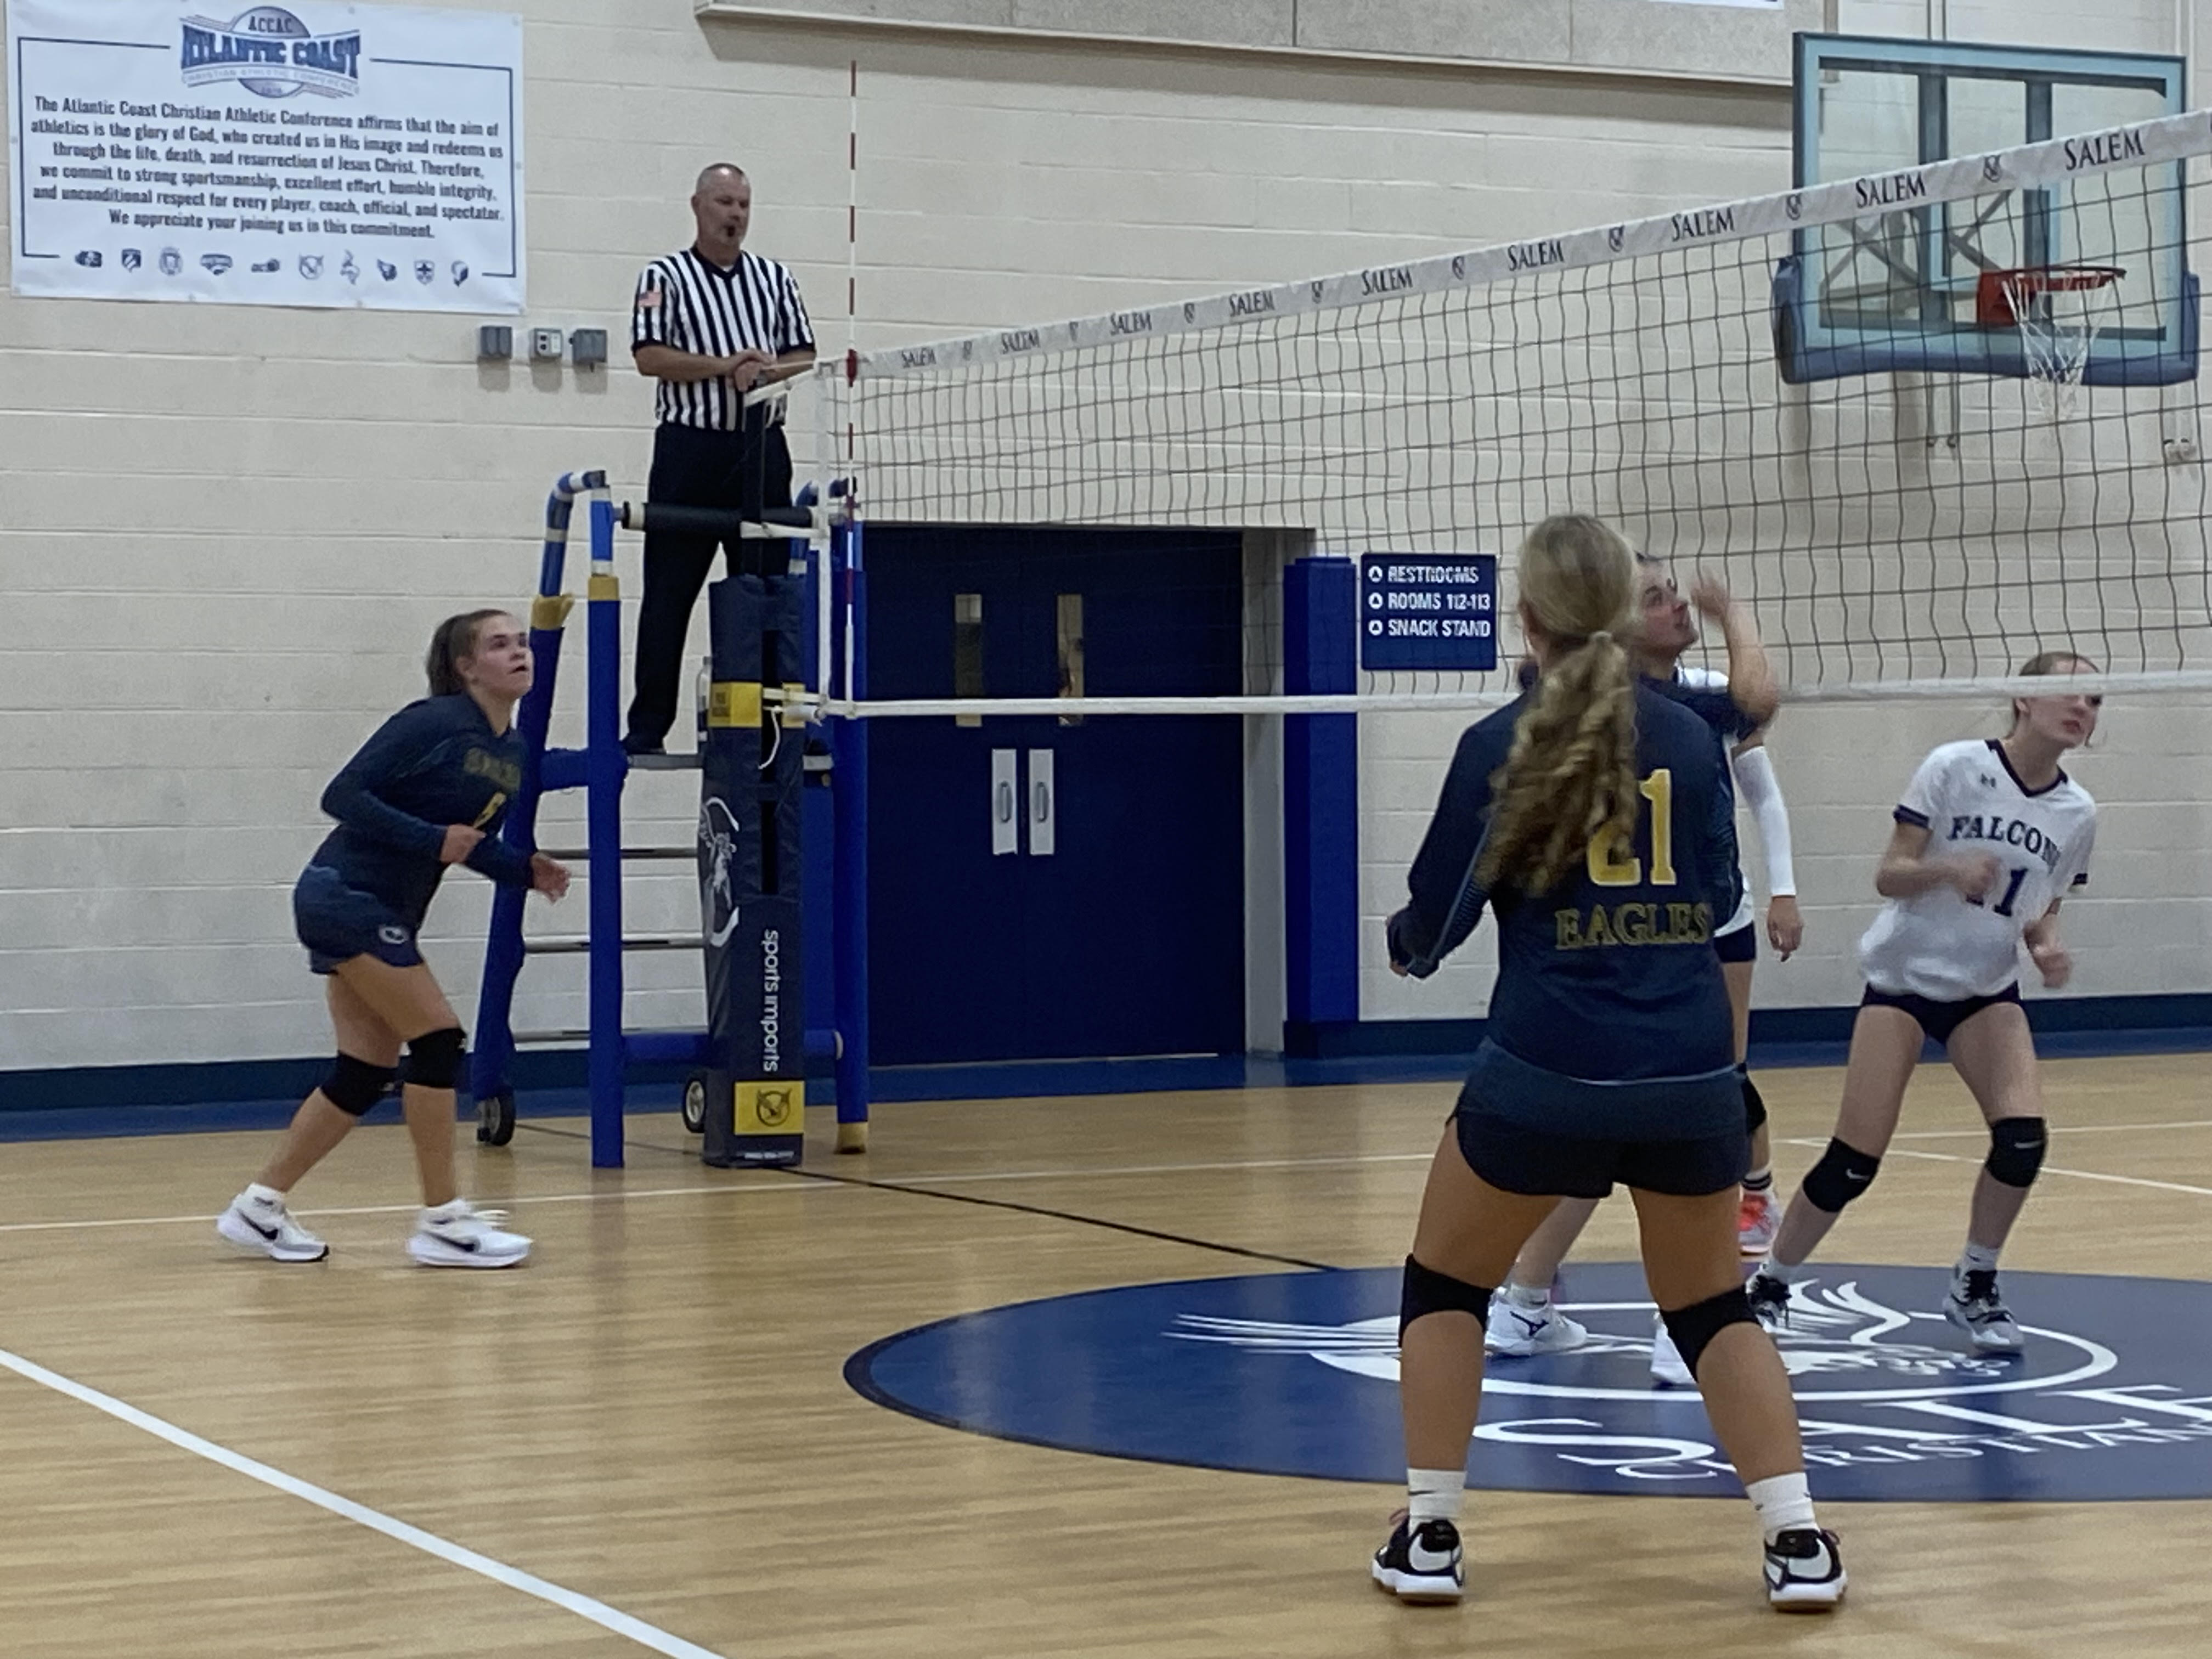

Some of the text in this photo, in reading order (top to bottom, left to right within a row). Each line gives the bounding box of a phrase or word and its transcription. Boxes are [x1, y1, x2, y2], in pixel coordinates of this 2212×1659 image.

[248, 16, 294, 33] ACCAC
[181, 25, 360, 78] ATLANTIC COAST
[35, 95, 499, 137] The Atlantic Coast Christian Athletic Conference affirms that the aim of
[31, 119, 503, 159] athletics is the glory of God, who created us in His image and redeems us
[2066, 128, 2146, 171] SALEM
[53, 142, 484, 179] through the life, death, and resurrection of Jesus Christ. Therefore,
[40, 166, 496, 201] we commit to strong sportsmanship, excellent effort, humble integrity,
[1855, 171, 1926, 208] SALEM
[33, 184, 503, 221] and unconditional respect for every player, coach, official, and spectator.
[109, 209, 435, 238] We appreciate your joining us in this commitment.
[1671, 207, 1735, 242] SALEM
[1508, 240, 1564, 272] SALEM
[1361, 268, 1413, 296] SALEM
[1229, 290, 1274, 317] SALEM
[1109, 312, 1152, 335] SALEM
[1001, 329, 1040, 354] SALEM
[901, 349, 936, 368] SALEM
[1387, 566, 1479, 583] RESTROOMS
[1387, 592, 1491, 610] ROOMS 112-113
[1387, 619, 1491, 637] SNACK STAND
[1555, 902, 1717, 950] EAGLES
[760, 929, 781, 1072] sports imports
